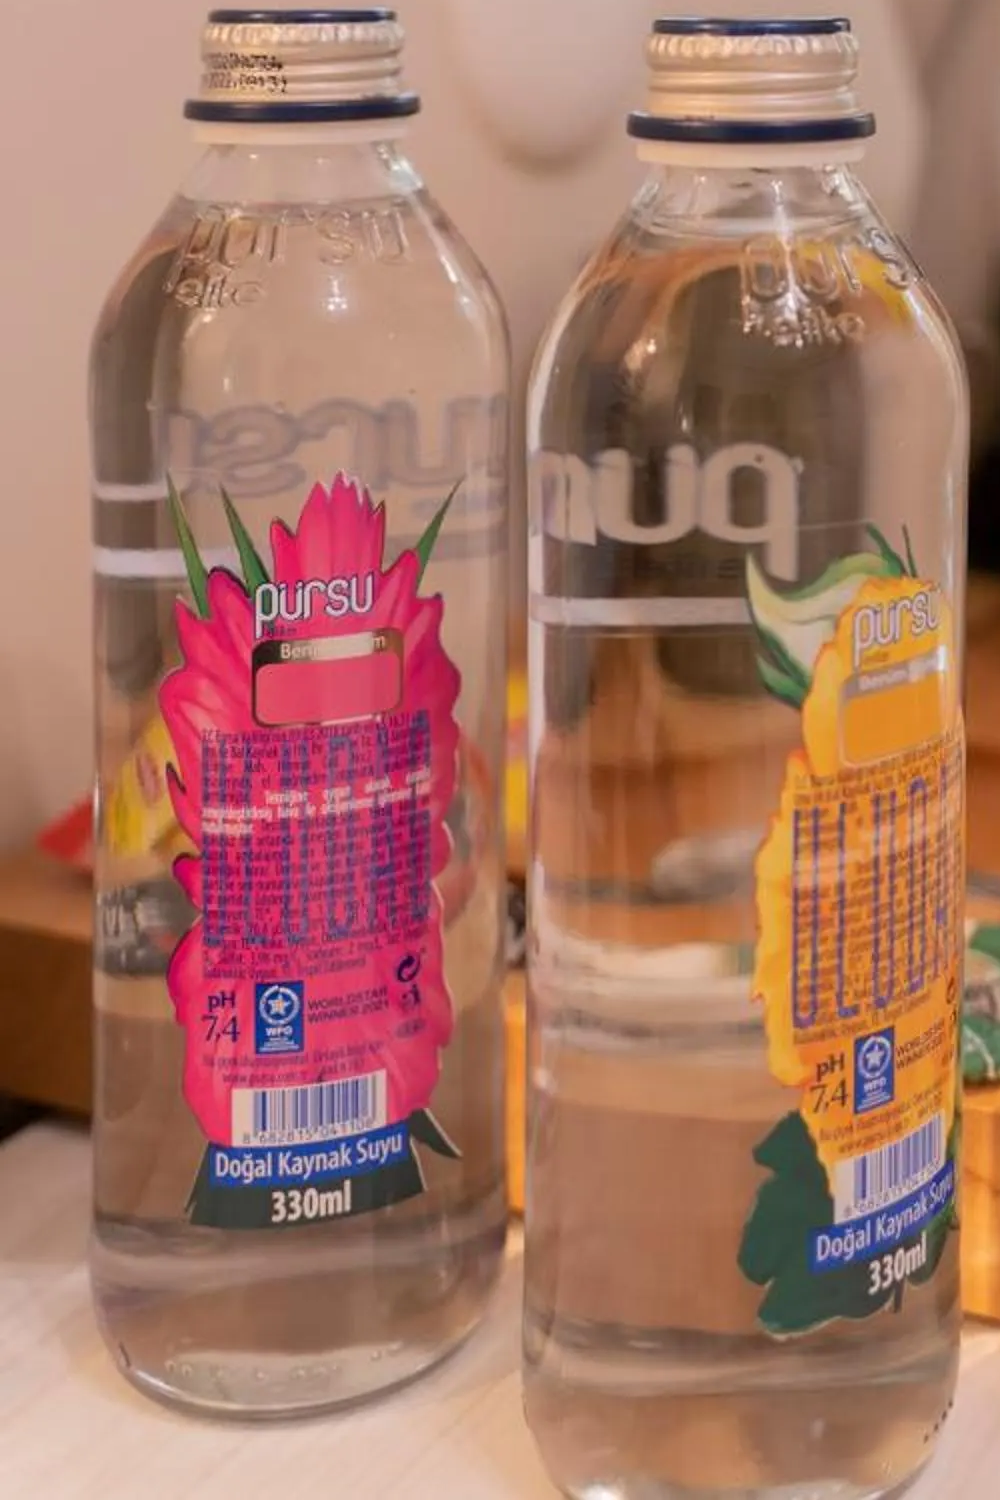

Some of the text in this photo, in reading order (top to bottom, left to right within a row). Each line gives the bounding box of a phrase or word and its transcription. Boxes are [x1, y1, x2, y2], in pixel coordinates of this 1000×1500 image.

[207, 990, 236, 1012] pH
[201, 1015, 240, 1043] 7,4
[815, 1052, 845, 1082] pH
[214, 1132, 403, 1184] Doğal Kaynak Suyu
[271, 1179, 351, 1223] 330ml
[816, 1220, 872, 1263] Doğal
[875, 1191, 928, 1244] Kaynak
[867, 1230, 928, 1296] 330ml
